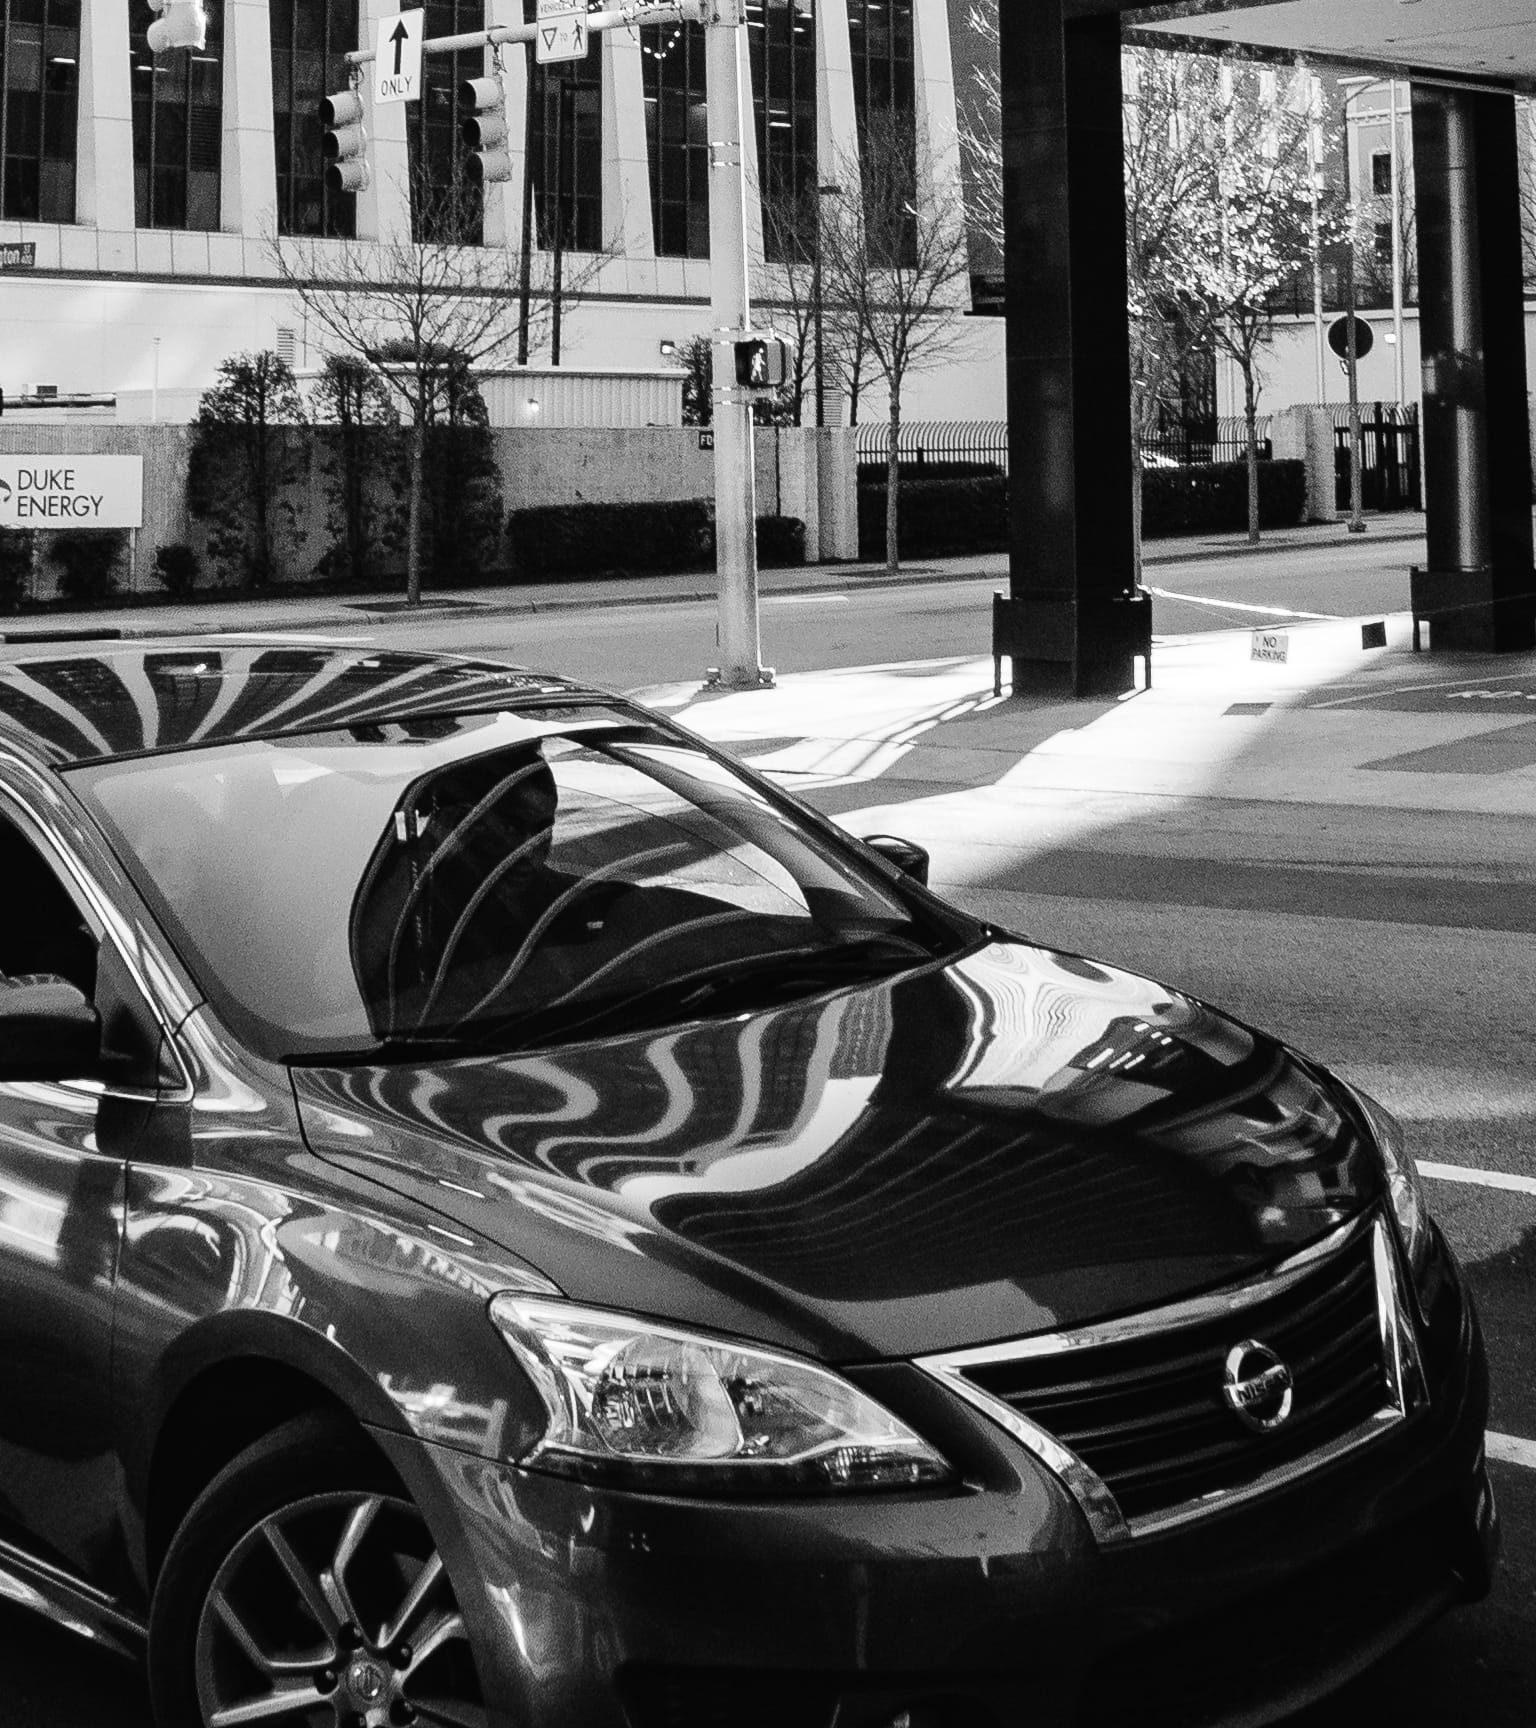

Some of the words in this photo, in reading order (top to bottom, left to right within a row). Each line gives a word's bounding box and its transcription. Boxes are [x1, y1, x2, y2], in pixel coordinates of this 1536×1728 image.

[380, 75, 413, 97] ONLY
[18, 469, 75, 491] DUKE
[17, 495, 104, 517] ENERGY
[1262, 635, 1278, 648] NO
[1251, 647, 1287, 662] PARKING
